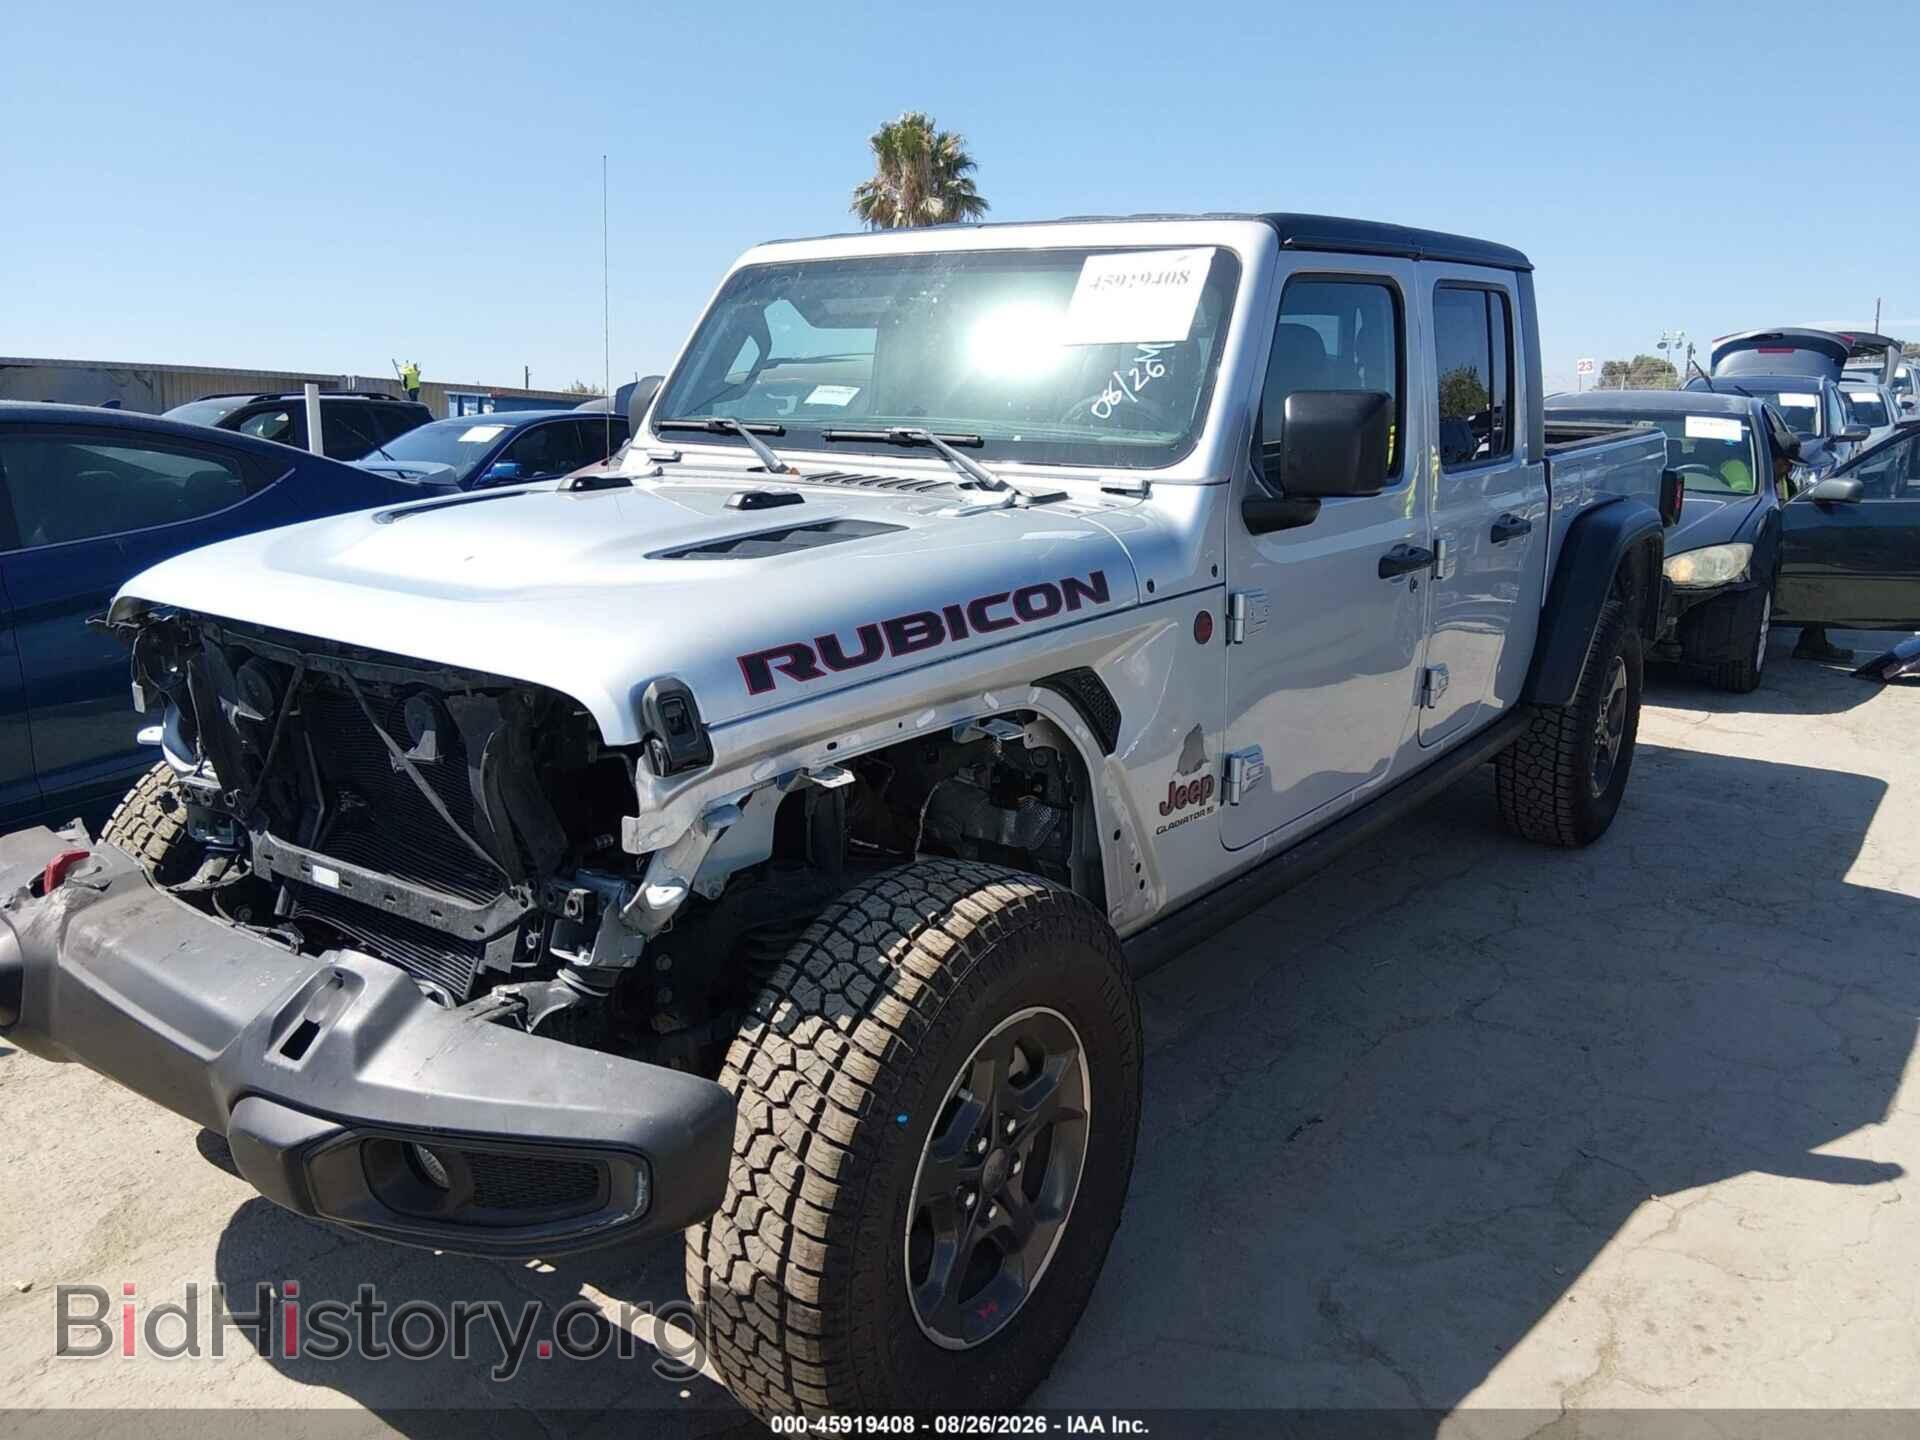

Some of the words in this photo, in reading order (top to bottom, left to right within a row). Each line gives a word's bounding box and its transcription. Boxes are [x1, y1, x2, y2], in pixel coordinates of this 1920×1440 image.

[1578, 360, 1593, 371] 23
[736, 569, 1111, 695] RUBICON
[1160, 774, 1215, 816] Jeep
[1156, 811, 1206, 835] GLADIATOR
